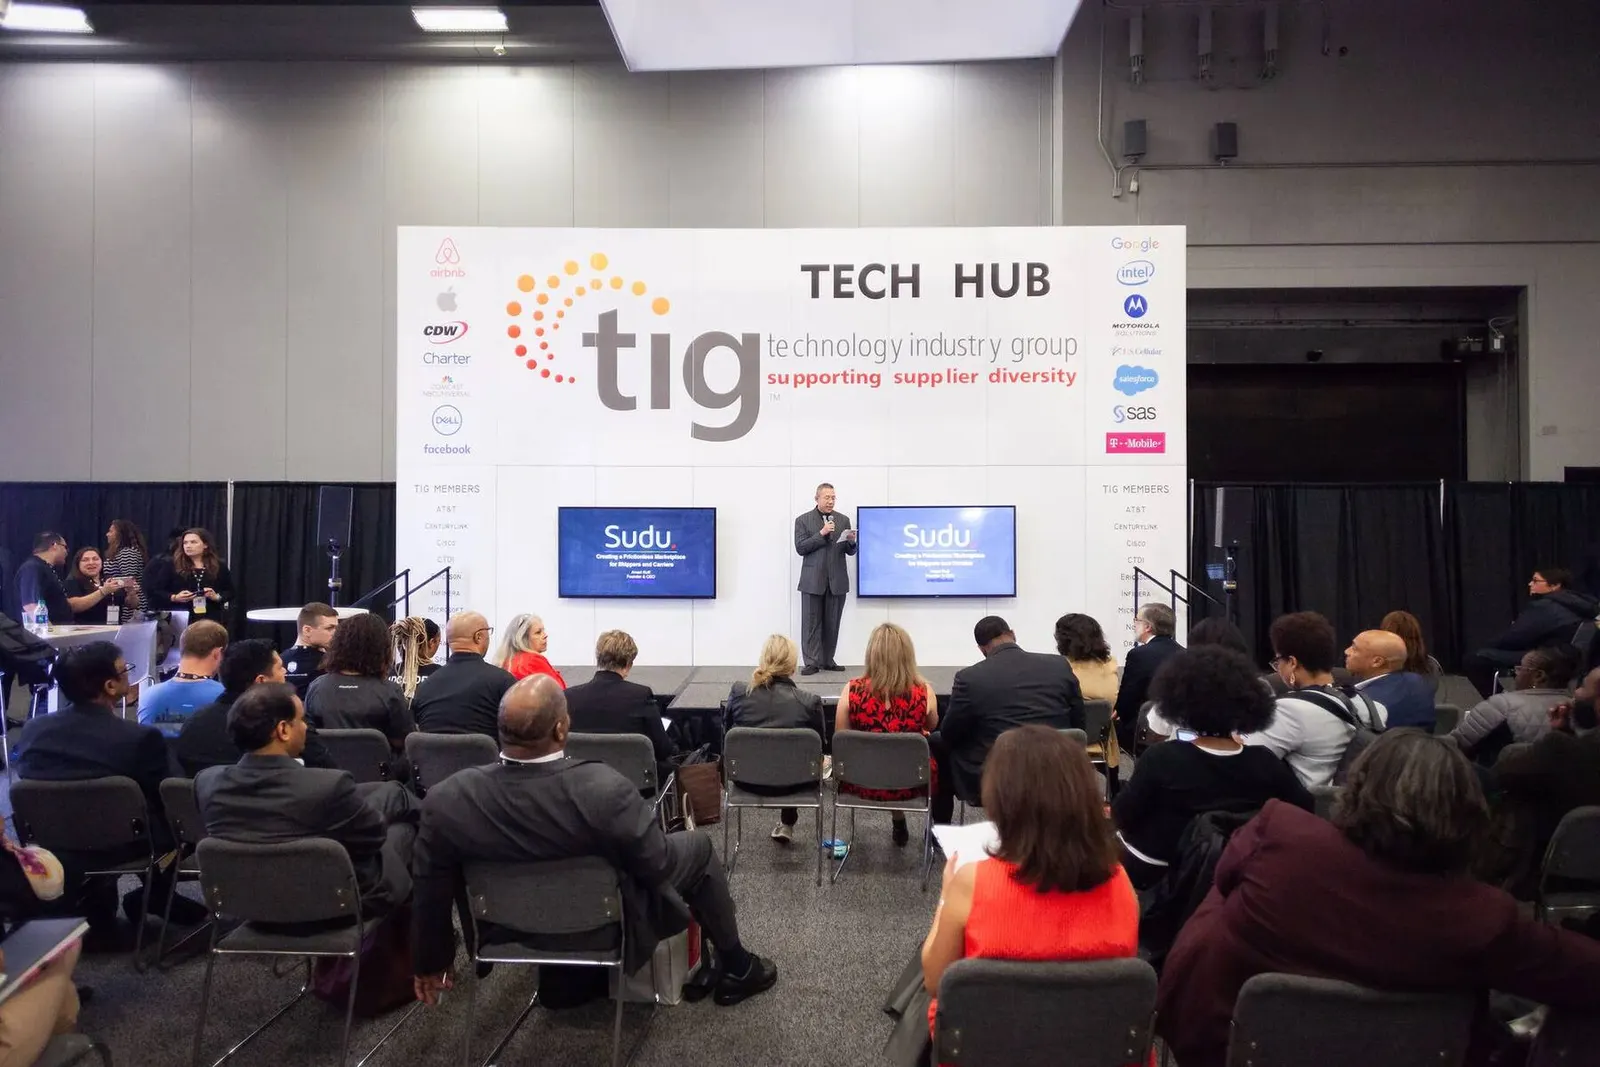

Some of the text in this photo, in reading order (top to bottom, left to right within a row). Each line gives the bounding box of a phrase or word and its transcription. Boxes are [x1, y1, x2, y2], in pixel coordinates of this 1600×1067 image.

[1111, 236, 1160, 252] Google
[430, 266, 466, 278] airbnb
[1121, 266, 1149, 278] intel
[801, 262, 1050, 299] TECH HUB
[423, 325, 459, 336] CDW
[1011, 336, 1077, 362] group
[423, 352, 471, 364] Charter
[582, 308, 761, 442] tig
[894, 368, 979, 387] supplier
[988, 367, 1077, 387] diversity
[424, 443, 471, 454] facebook
[414, 484, 480, 493] TIG MEMBERS
[1102, 484, 1170, 494] TIG MEMBERS
[1126, 505, 1146, 513] AT&T
